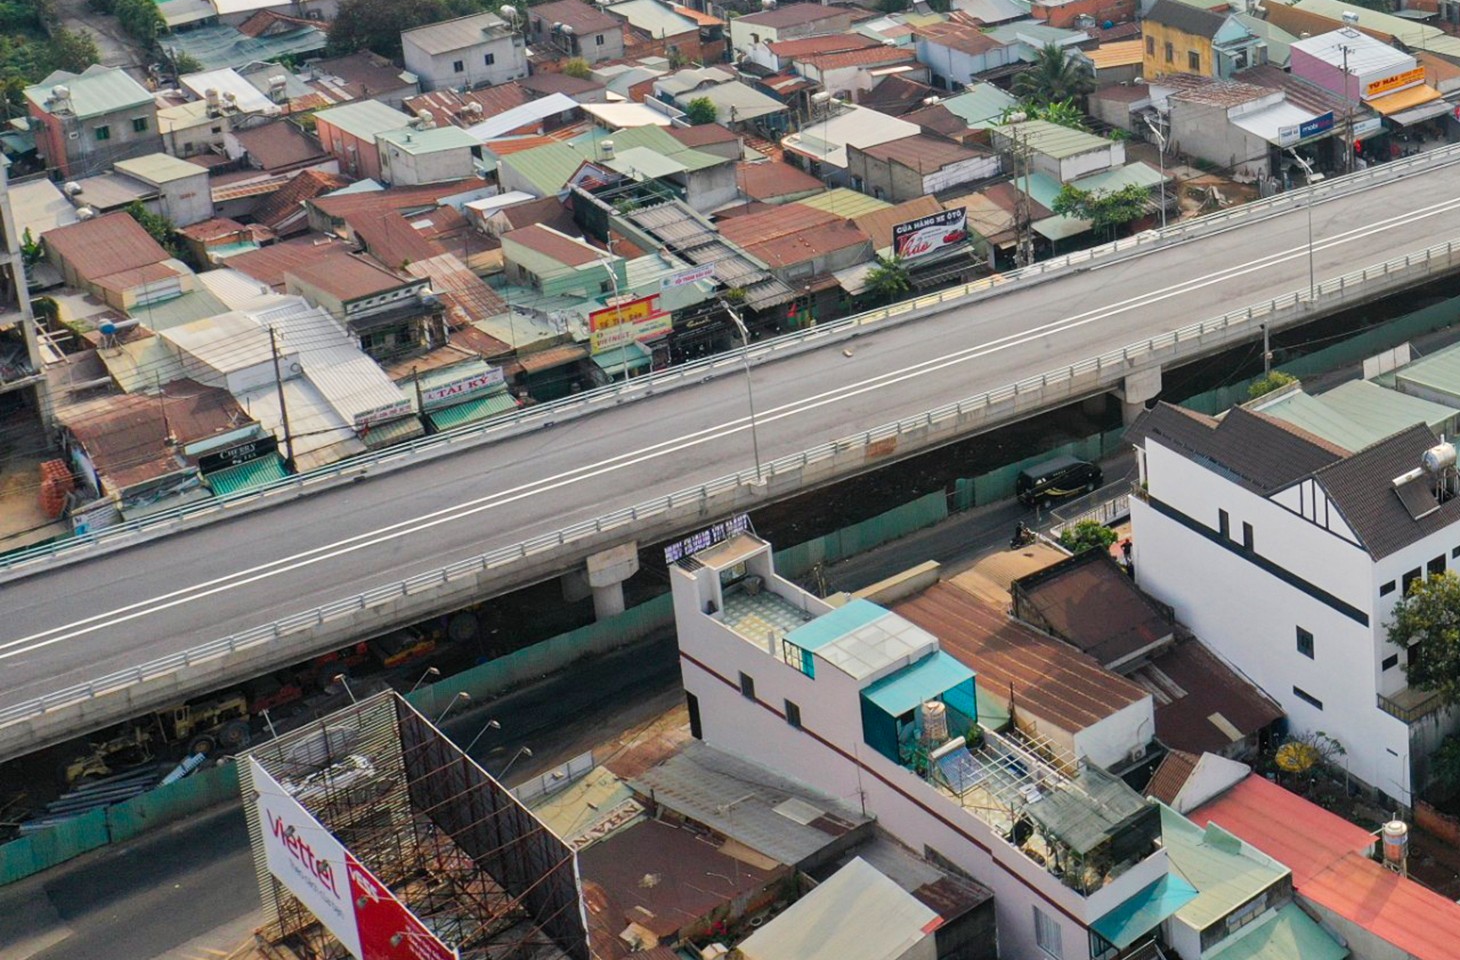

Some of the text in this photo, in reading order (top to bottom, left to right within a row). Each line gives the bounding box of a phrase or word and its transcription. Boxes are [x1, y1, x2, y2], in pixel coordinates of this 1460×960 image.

[896, 223, 913, 234] CỬA
[914, 218, 935, 230] HÀNG
[936, 214, 946, 223] XE
